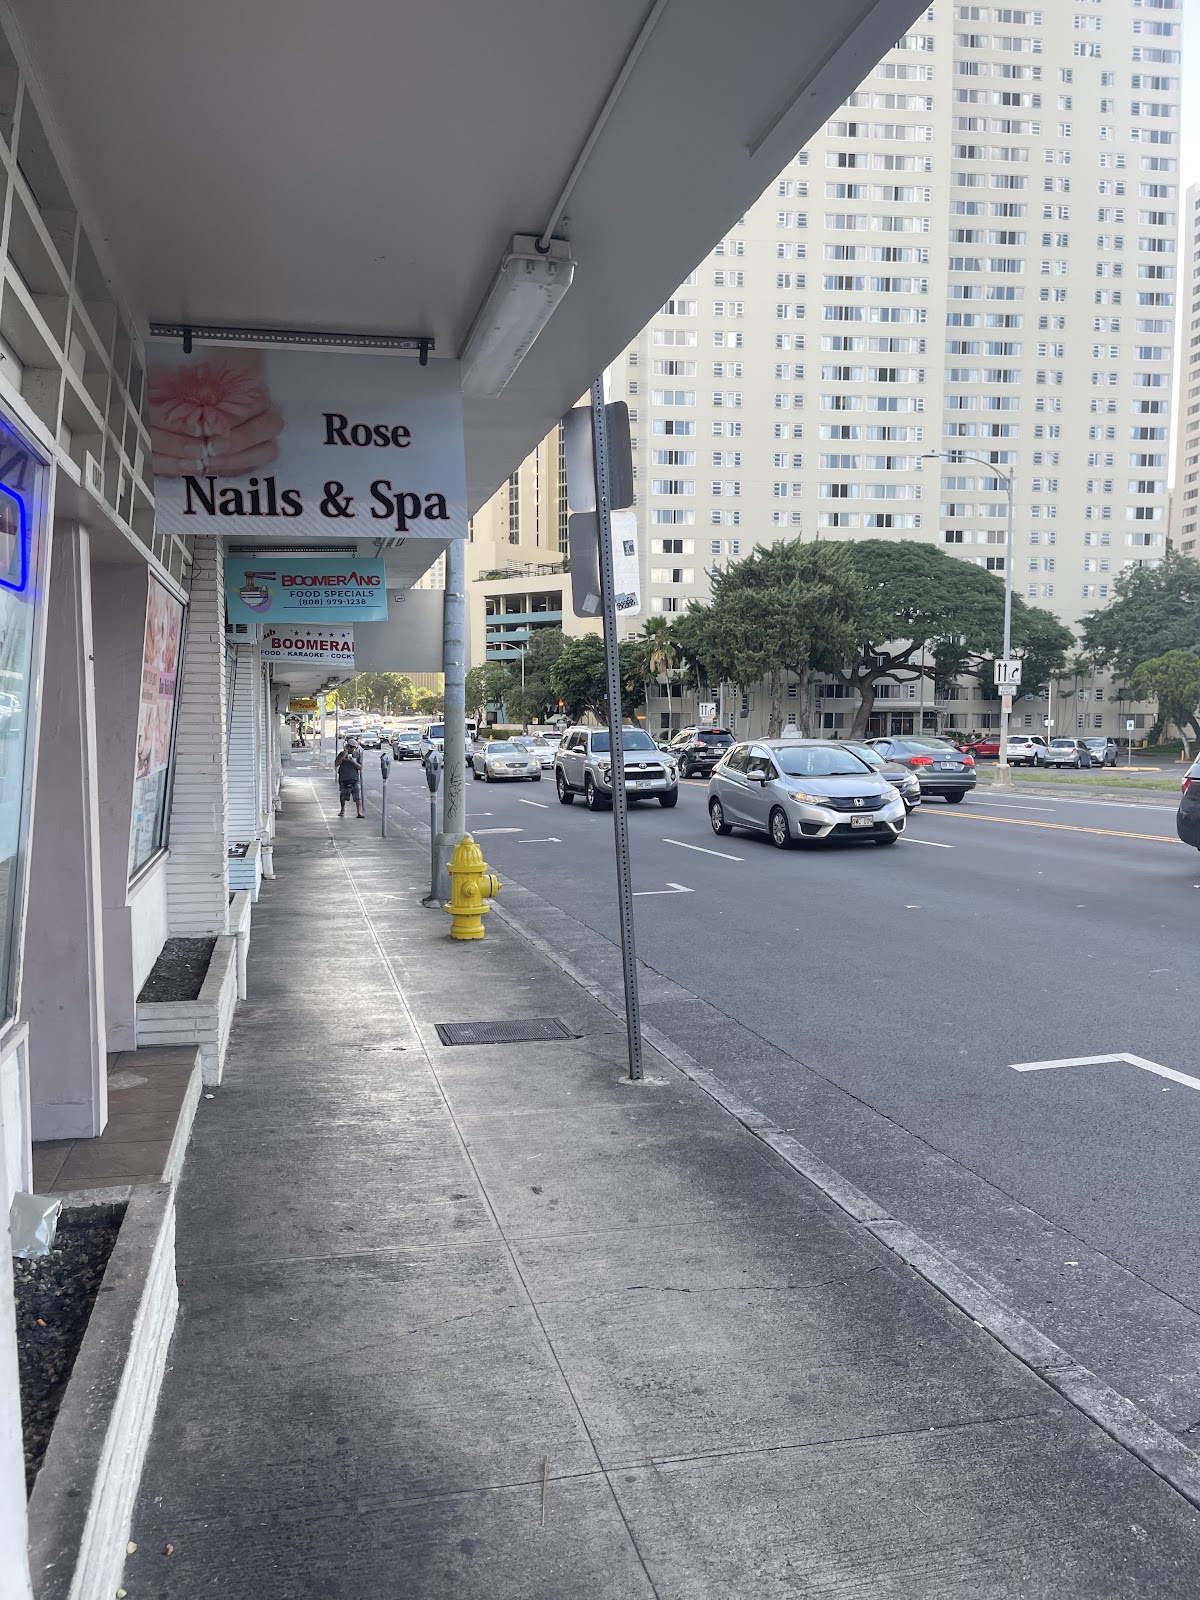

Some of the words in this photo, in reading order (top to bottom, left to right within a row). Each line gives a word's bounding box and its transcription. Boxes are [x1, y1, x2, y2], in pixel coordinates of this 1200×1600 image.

[322, 412, 412, 447] Rose
[181, 475, 303, 517] Nails
[319, 480, 355, 518] &
[369, 479, 450, 532] Spa
[281, 571, 381, 587] BOOMERANG
[290, 590, 321, 598] FOOD
[299, 598, 323, 606] (808)
